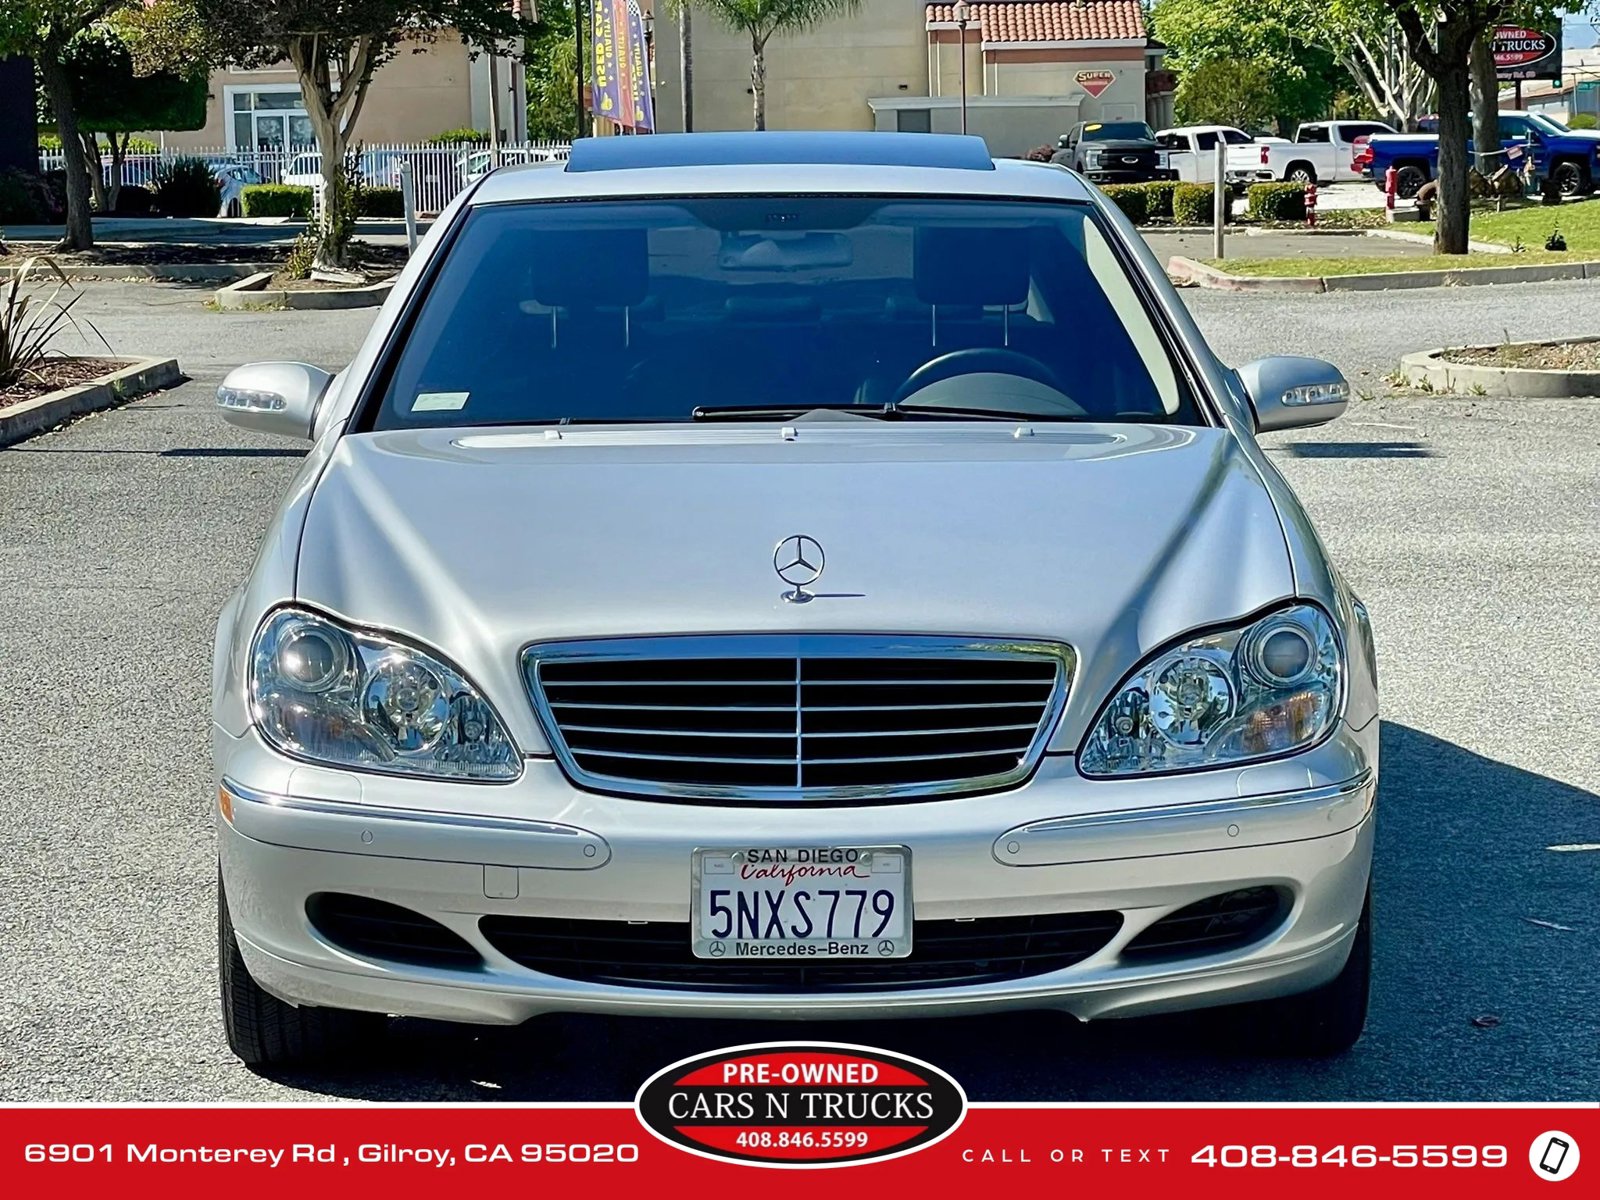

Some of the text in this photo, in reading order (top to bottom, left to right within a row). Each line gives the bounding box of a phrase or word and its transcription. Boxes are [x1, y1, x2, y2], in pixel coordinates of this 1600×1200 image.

[747, 849, 859, 864] SAN DIEGO
[740, 863, 871, 887] California
[709, 889, 895, 939] 5NXS779
[736, 942, 869, 956] Mercedes-Benz
